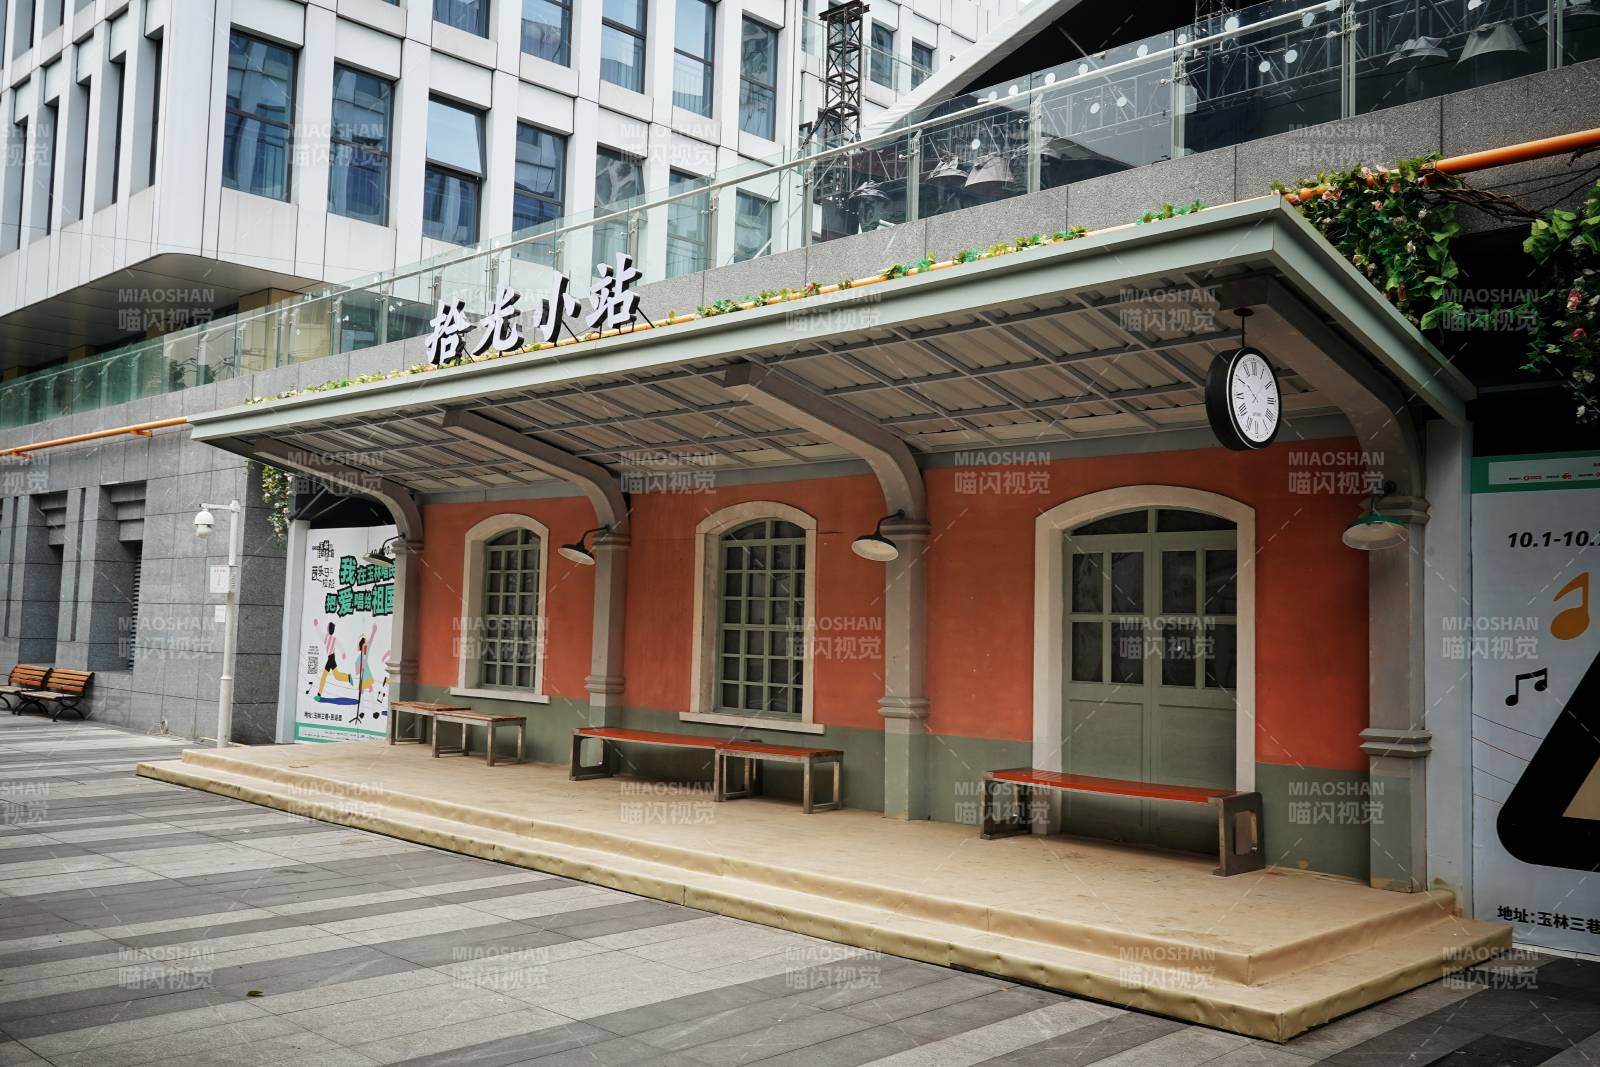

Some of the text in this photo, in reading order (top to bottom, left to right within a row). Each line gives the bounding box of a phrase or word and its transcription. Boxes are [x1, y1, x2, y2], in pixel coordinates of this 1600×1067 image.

[425, 252, 643, 365] 拾光小站
[1508, 530, 1600, 548] 10.1-10.
